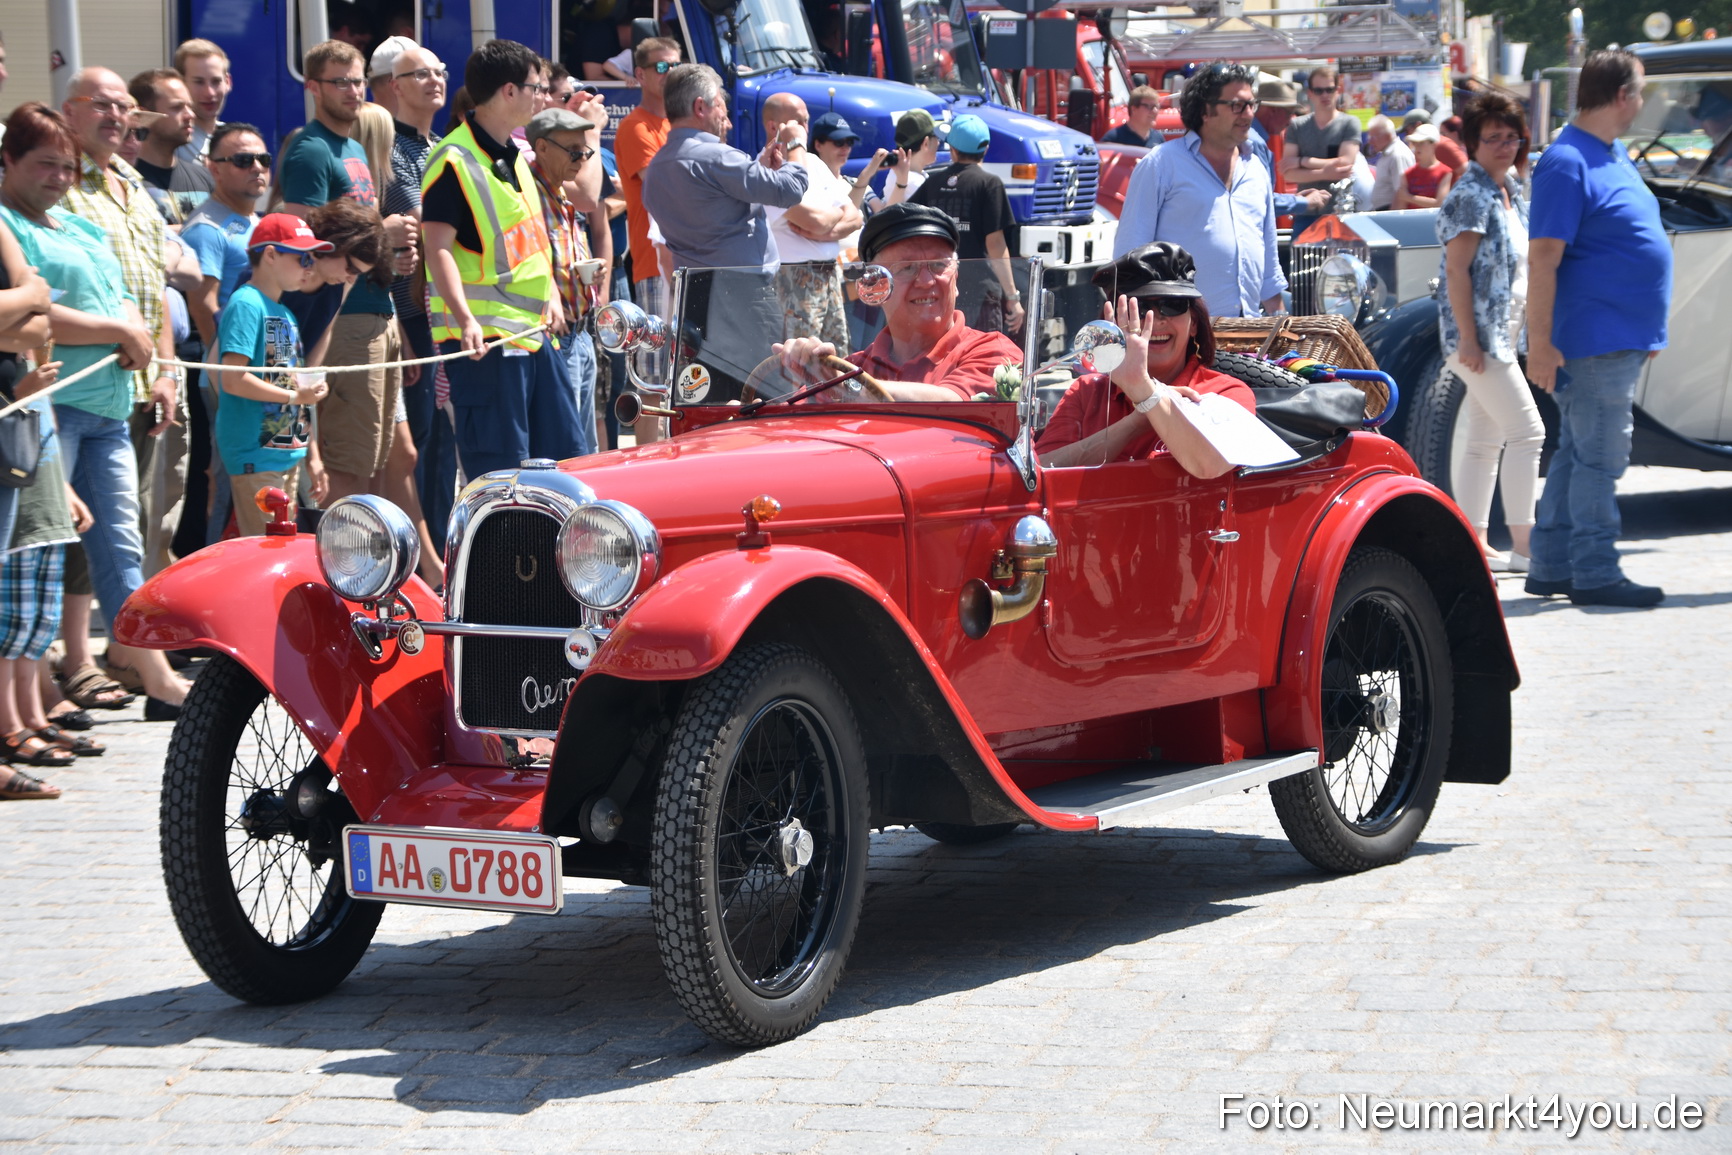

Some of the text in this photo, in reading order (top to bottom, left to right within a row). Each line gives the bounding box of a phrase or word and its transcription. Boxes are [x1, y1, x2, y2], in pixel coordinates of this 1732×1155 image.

[358, 869, 366, 882] D
[378, 842, 543, 899] AA 0788
